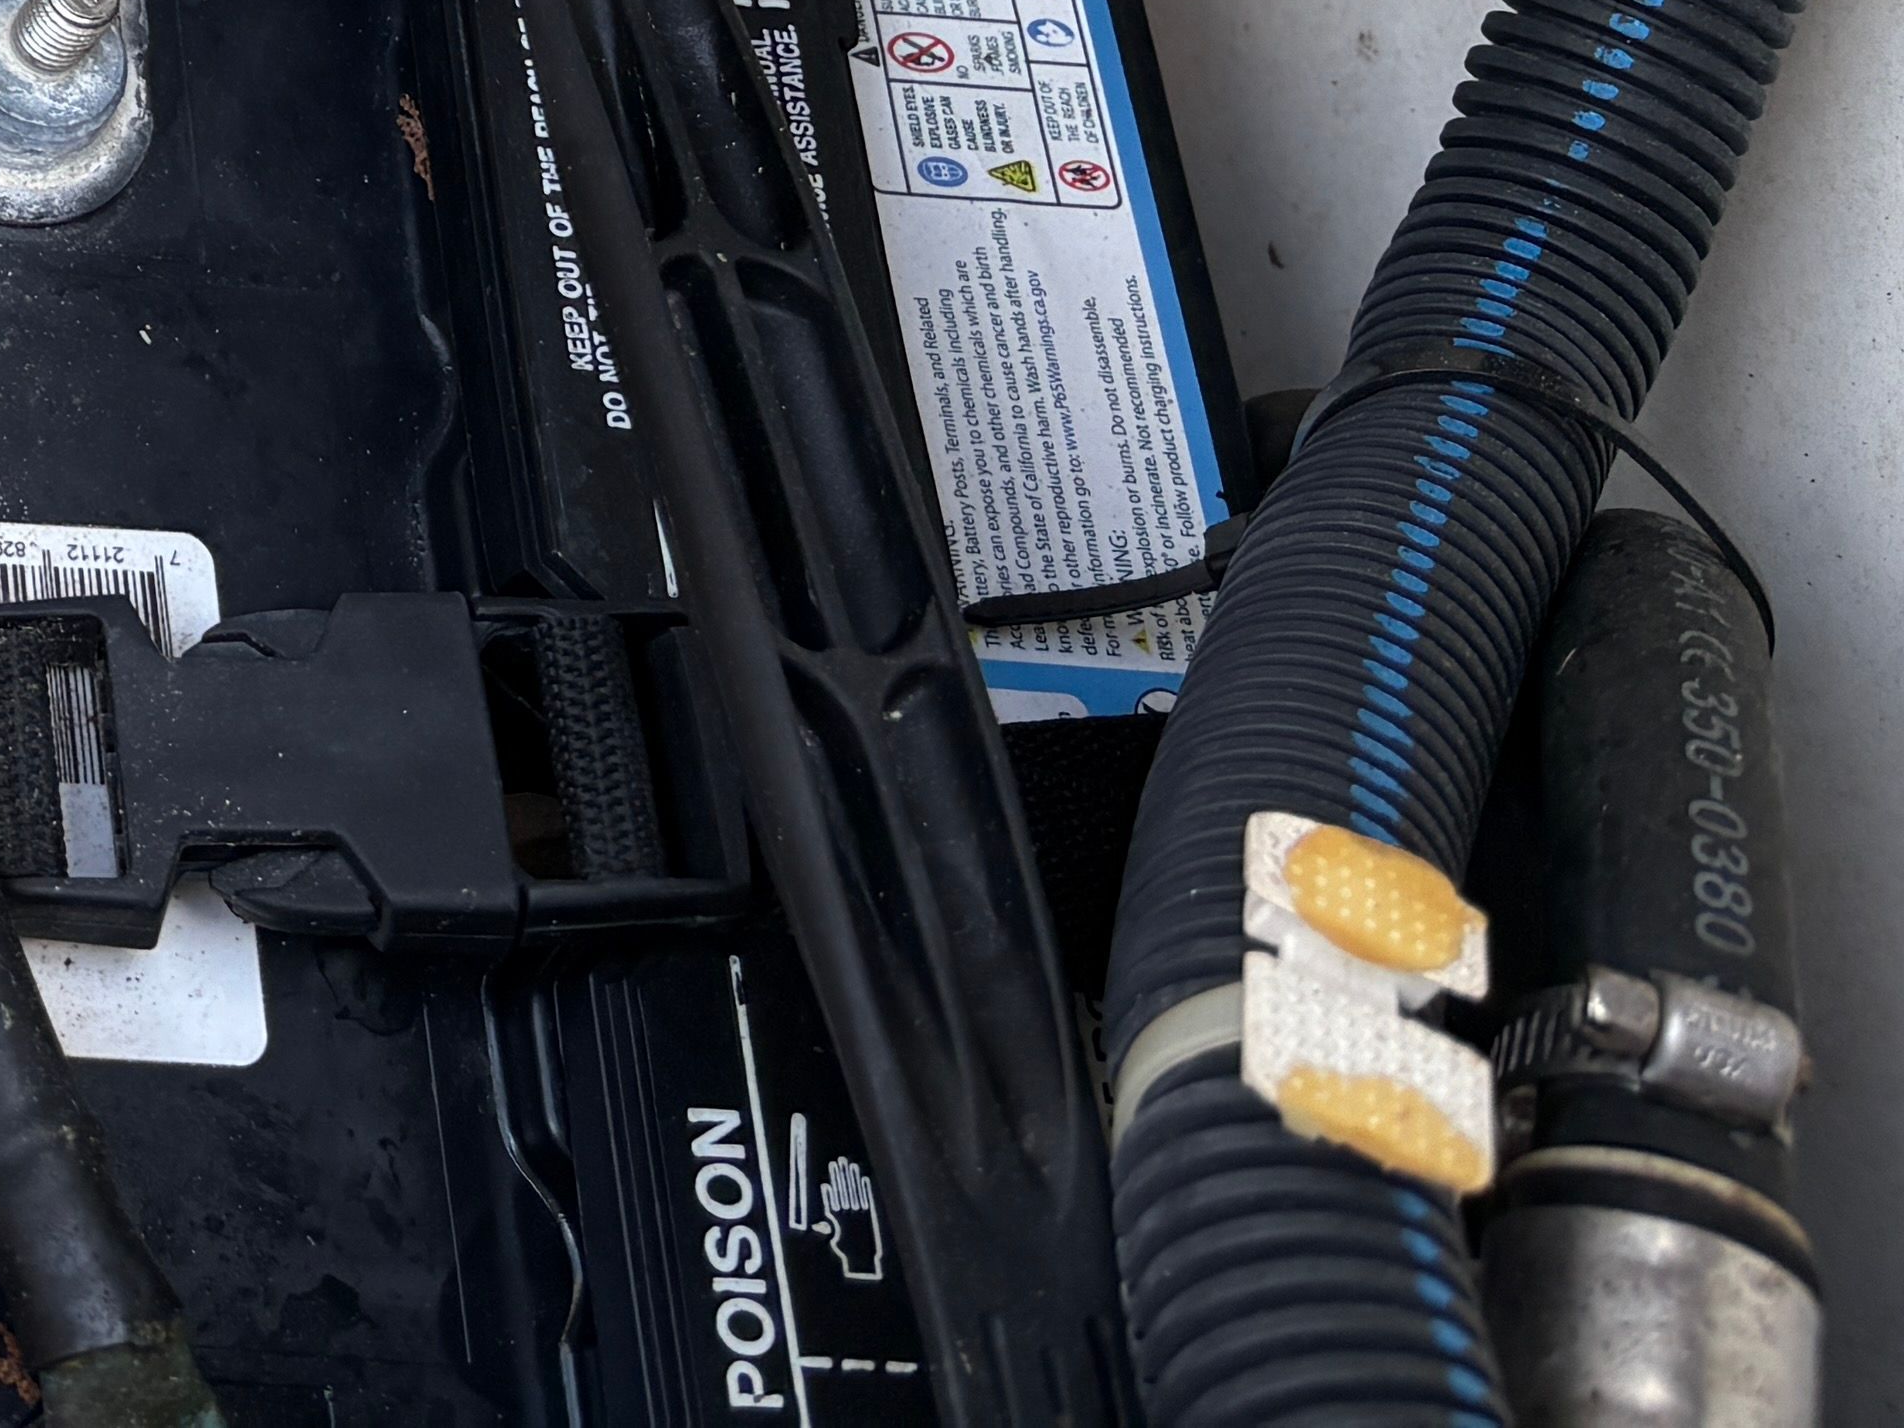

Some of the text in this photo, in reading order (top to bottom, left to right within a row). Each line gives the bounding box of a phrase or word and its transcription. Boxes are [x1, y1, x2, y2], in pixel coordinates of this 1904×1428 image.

[774, 26, 817, 164] ASSISTANCE.
[546, 200, 573, 237] OF
[552, 243, 582, 299] OUT
[561, 304, 594, 373] KEEP
[914, 297, 937, 349] Related
[1083, 297, 1114, 384] disassemble,
[925, 352, 946, 380] and
[991, 208, 1081, 579] other reproductive harm. Wash hands after handling.
[1103, 387, 1121, 412] not
[603, 390, 631, 431] DO
[934, 383, 960, 453] Terminals,
[938, 288, 1006, 562] can expose you to chemicals including
[955, 259, 1031, 570] Compounds, and other chemicals which are
[972, 246, 1057, 580] the State of California to cause cancer and birth
[1108, 317, 1175, 550] or incinerate. Not recommended
[1110, 414, 1128, 436] Do
[1126, 275, 1196, 538] Follow product charging instructions.
[951, 457, 969, 498] Posts,
[1023, 268, 1121, 657] For information go to: www.P65Warnings.ca.gov
[1117, 439, 1137, 485] burns.
[1127, 488, 1142, 504] or
[66, 543, 123, 562] 21112
[168, 549, 179, 564] 7
[961, 502, 981, 555] Battery
[1132, 510, 1160, 579] explosion
[1107, 527, 1146, 626] WNING:
[1153, 612, 1169, 629] of
[1682, 679, 1756, 957] 350-0380
[687, 1106, 785, 1409] POISON
